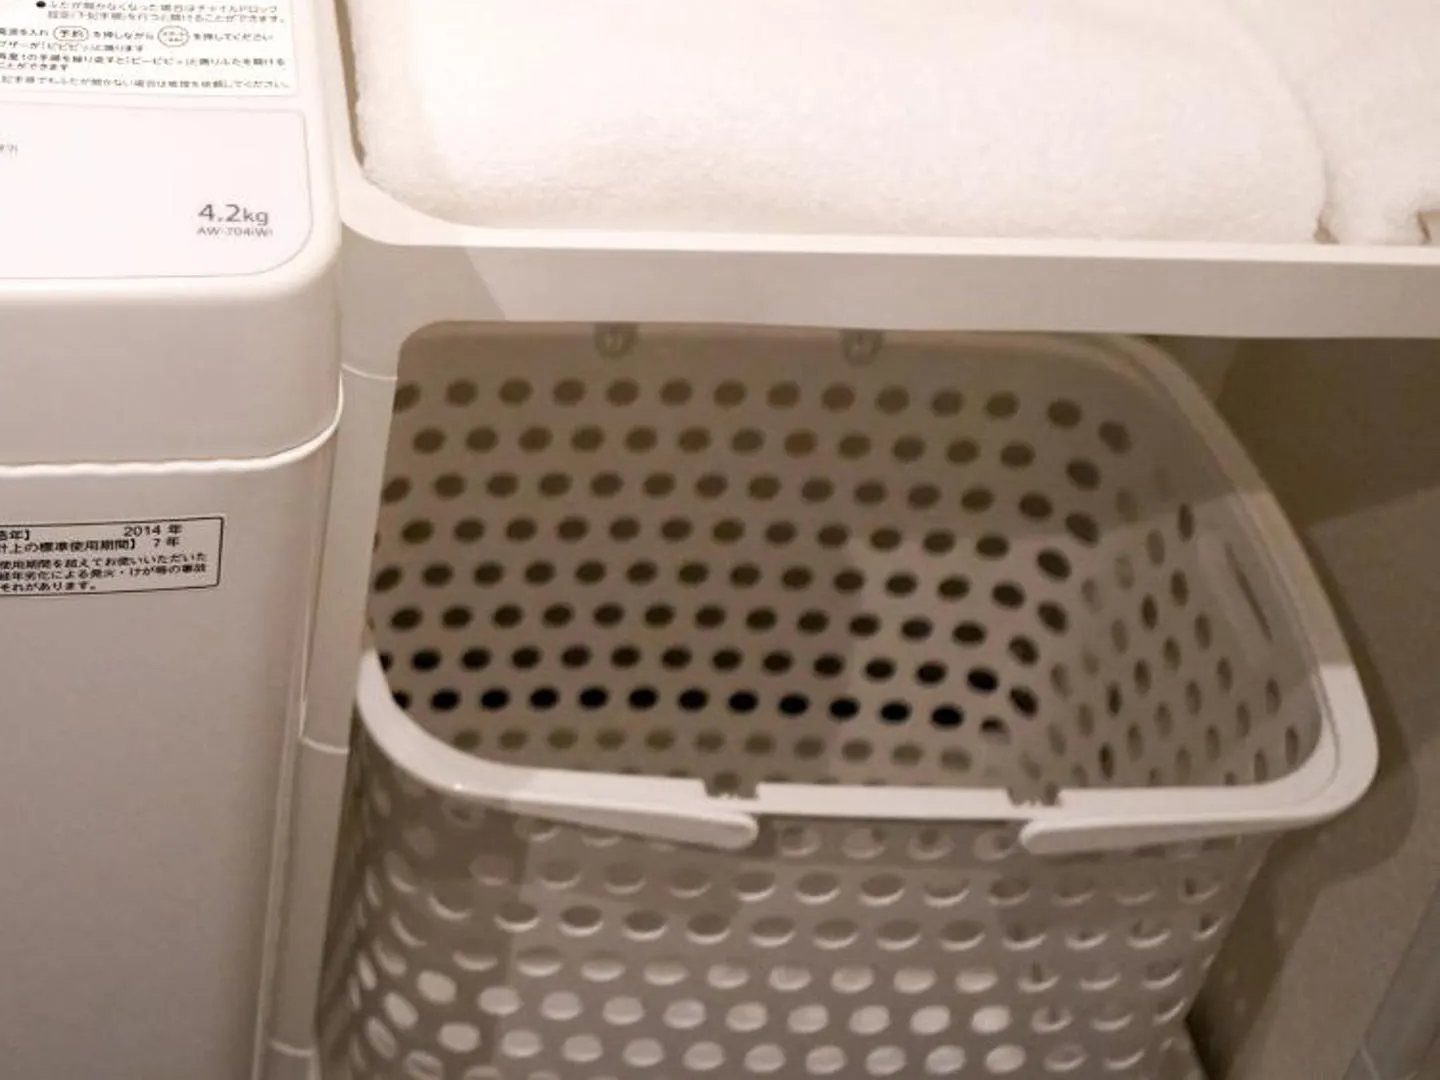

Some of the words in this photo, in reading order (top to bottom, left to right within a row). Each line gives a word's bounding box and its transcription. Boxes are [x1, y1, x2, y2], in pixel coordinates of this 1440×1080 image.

[197, 203, 270, 227] 4.2kg
[123, 525, 162, 538] 2014
[167, 524, 184, 535] 年
